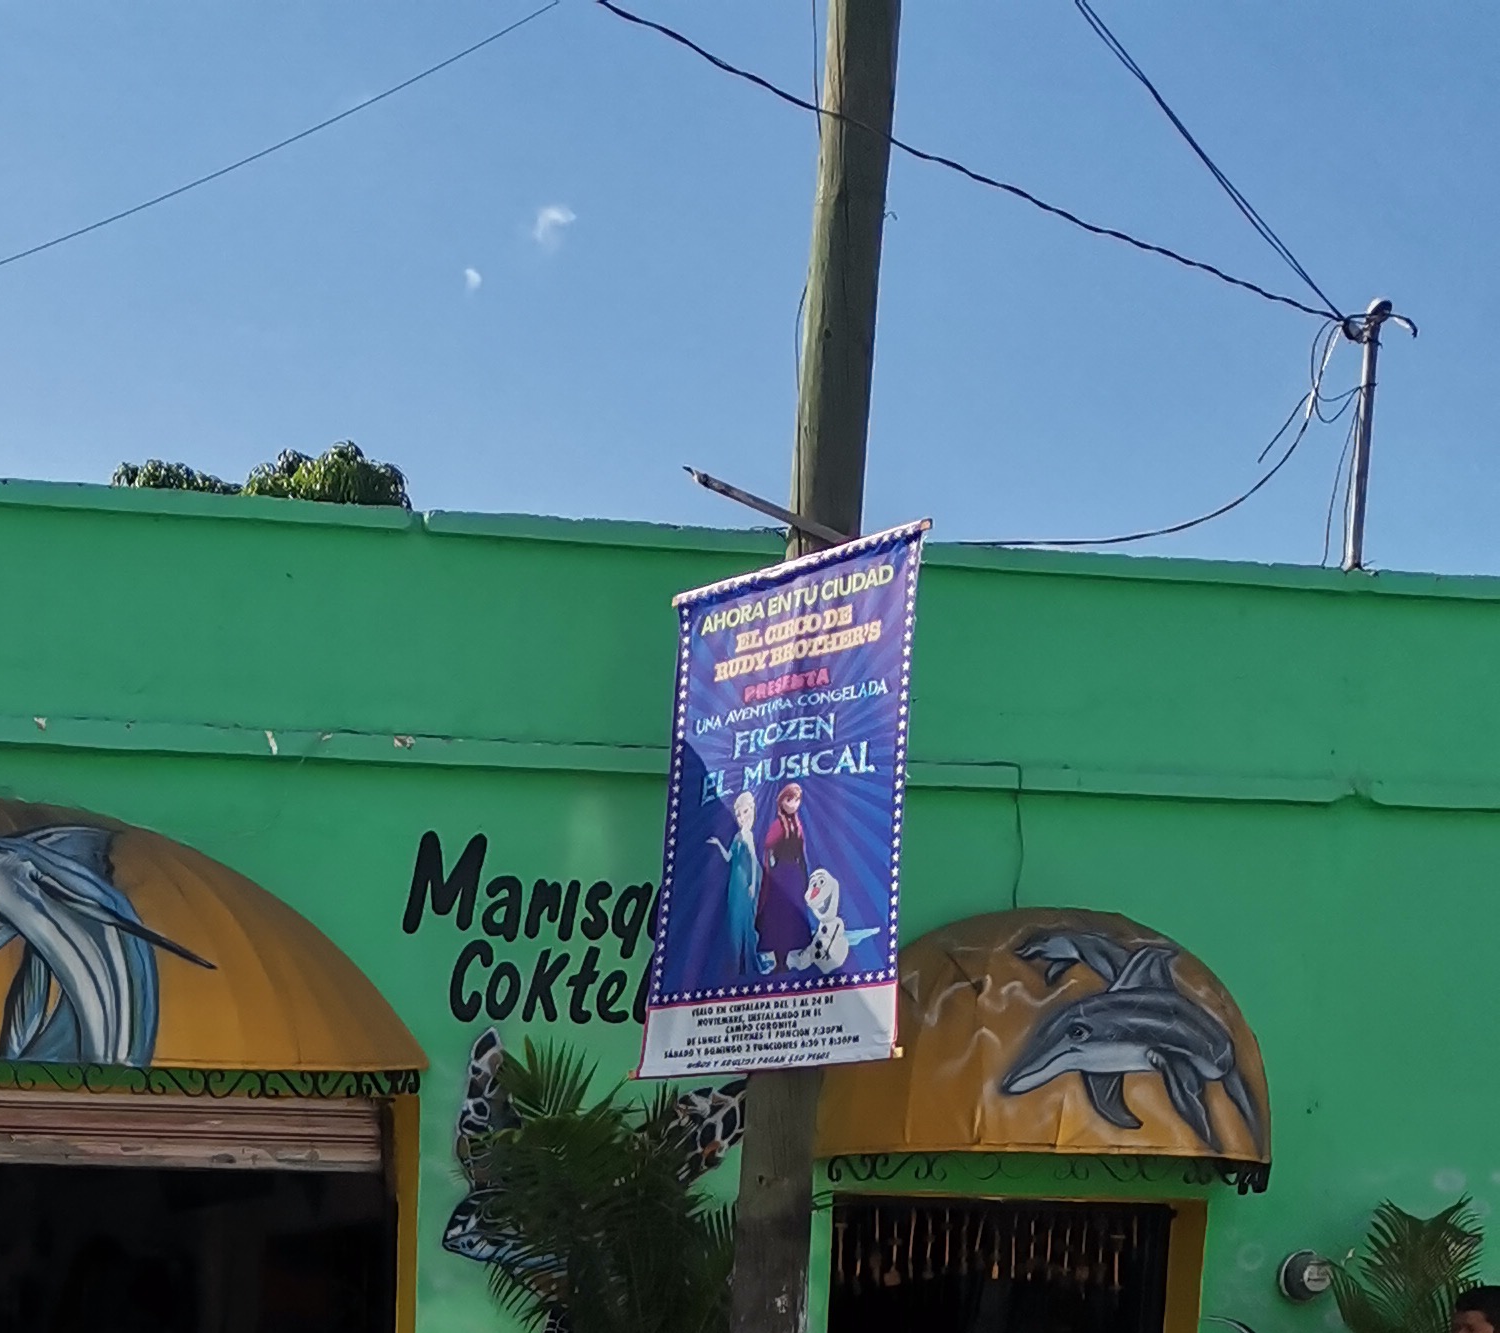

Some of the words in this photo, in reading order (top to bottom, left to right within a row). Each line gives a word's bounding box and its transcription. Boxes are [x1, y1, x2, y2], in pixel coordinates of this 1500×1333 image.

[701, 603, 765, 636] AHORA
[766, 594, 792, 617] EN
[793, 585, 818, 607] TU
[821, 564, 895, 601] CIUDAD
[714, 649, 770, 683] RUDY
[769, 620, 882, 668] BROTHER'S
[735, 629, 764, 653] EL
[764, 612, 822, 647] CIRCO
[823, 603, 854, 632] DE
[694, 714, 723, 736] UNA
[724, 696, 794, 726] AVENTURA
[797, 677, 889, 707] CONGELADA
[743, 667, 831, 704] PRESENTA
[732, 711, 836, 761] FROZEN
[700, 768, 735, 807] EL
[741, 739, 877, 792] MUSICAL
[716, 1005, 727, 1015] EN
[774, 999, 789, 1009] DEL
[755, 1020, 797, 1031] CORONITA
[698, 1033, 722, 1045] LUNES
[731, 1031, 764, 1043] VIERNES
[704, 1044, 743, 1057] DOMINGO
[753, 1040, 798, 1052] FUNCIONES
